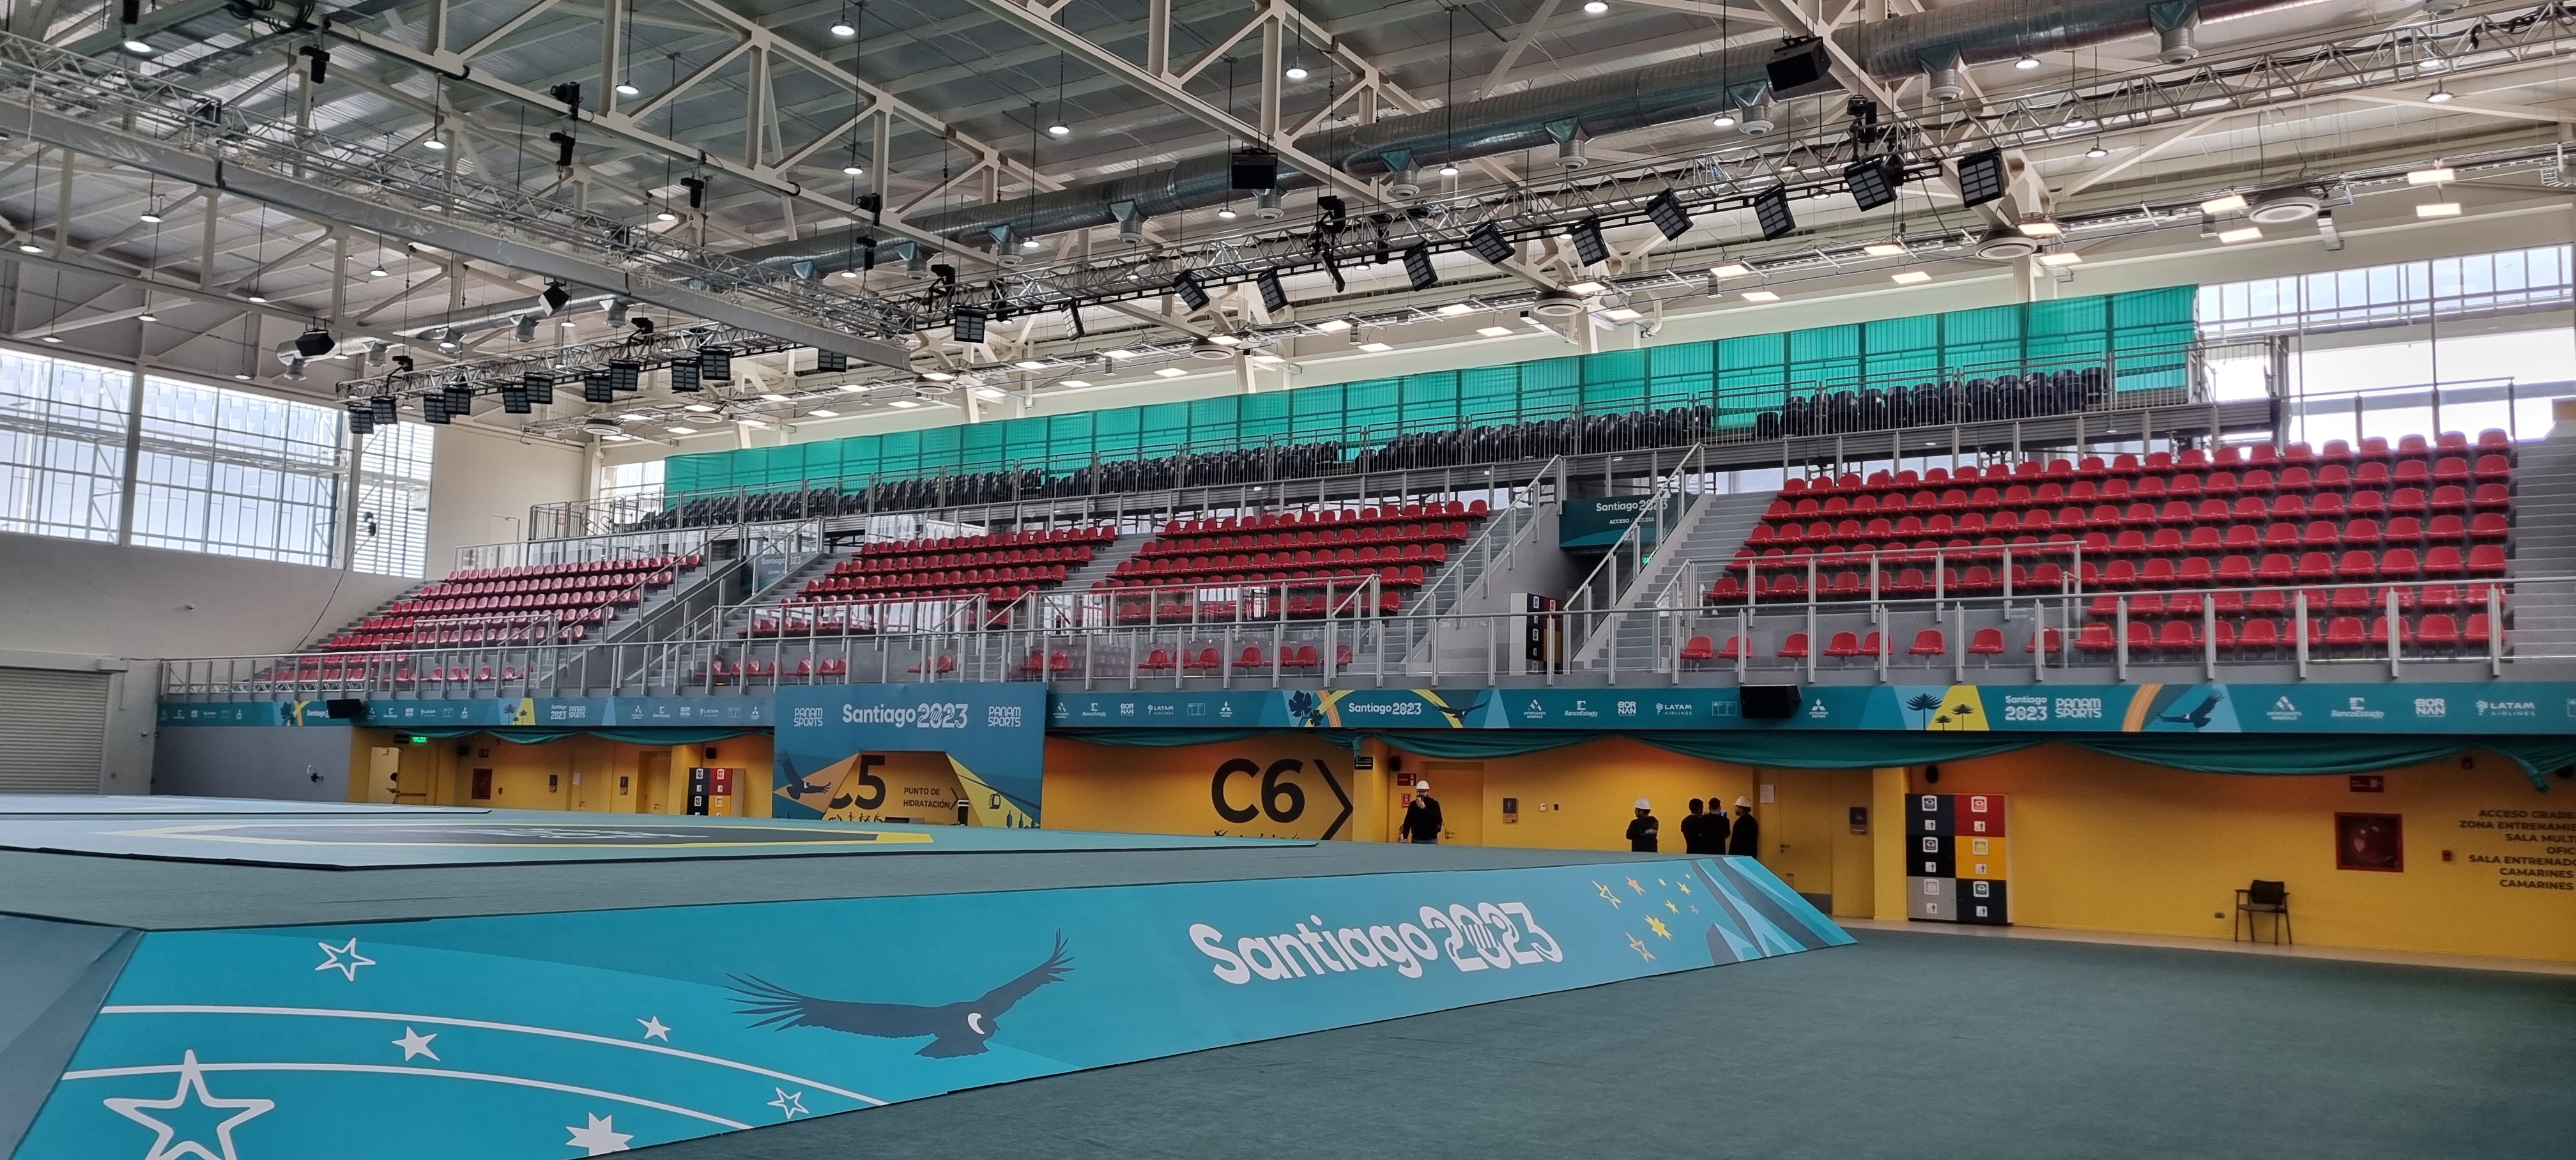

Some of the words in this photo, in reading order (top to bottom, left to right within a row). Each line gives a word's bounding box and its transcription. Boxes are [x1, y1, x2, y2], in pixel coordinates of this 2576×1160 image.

[1596, 501, 1638, 512] Santiago
[1639, 498, 1668, 511] 23
[2005, 695, 2048, 705] Santiago
[2055, 698, 2102, 708] PANAM
[2416, 698, 2446, 707] BOR
[794, 707, 823, 717] PANAM
[988, 706, 1021, 717] PANAM
[1349, 703, 1392, 715] Santiago
[1392, 702, 1422, 715] 2023
[2005, 706, 2048, 721] 2023
[2055, 708, 2103, 719] SPORTS
[2416, 706, 2446, 715] NAN
[550, 710, 567, 720] 2023
[842, 703, 916, 728] Santiago
[917, 703, 969, 729] 2023
[793, 717, 823, 728] SPORTS
[988, 717, 1021, 728] SPORTS
[903, 787, 929, 795] PUNTO
[930, 788, 940, 796] DE
[1211, 758, 1305, 823] C6
[903, 798, 951, 809] HIDRATACIÓN
[2478, 809, 2527, 818] ACCESO
[2459, 820, 2494, 829] ZONA
[2505, 833, 2538, 842] SALA
[2547, 846, 2576, 855] OFIC
[2468, 854, 2501, 864] SALA
[2499, 867, 2573, 878] CAMARINES
[2499, 879, 2574, 890] CAMARINES
[1189, 915, 1438, 984] Santiago
[1419, 902, 1563, 972] 2023
